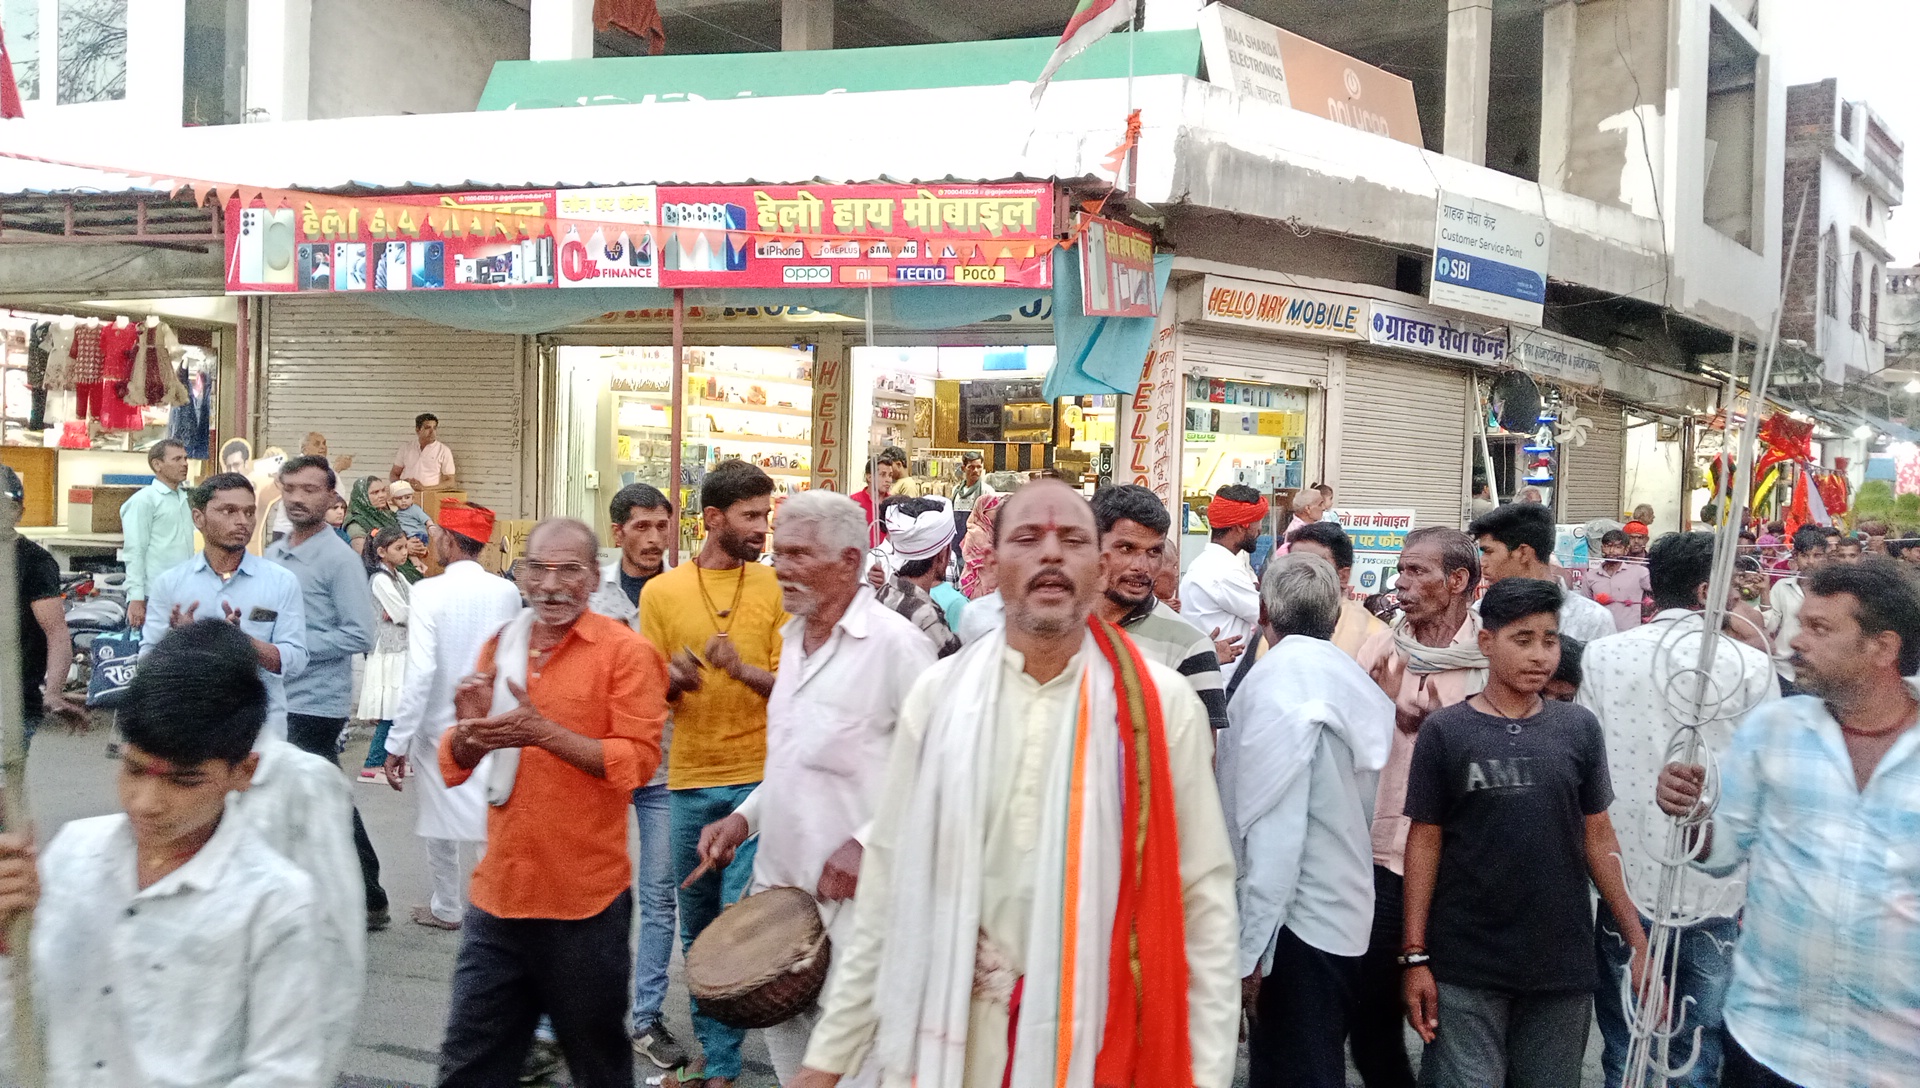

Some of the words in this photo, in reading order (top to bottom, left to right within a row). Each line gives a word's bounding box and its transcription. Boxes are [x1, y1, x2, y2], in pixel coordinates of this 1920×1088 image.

[1224, 26, 1245, 47] MAA
[1246, 34, 1279, 59] SHARDA
[1229, 51, 1284, 81] ELECTRONICS
[754, 190, 824, 229] हेलो
[832, 198, 895, 229] हाय
[902, 188, 1038, 237] मोबाइल
[1443, 204, 1465, 222] ग्राहक
[1466, 207, 1482, 227] सेवा
[766, 245, 801, 256] iPhone
[869, 245, 916, 254] SAMNG
[1441, 227, 1478, 248] Customer
[1479, 237, 1505, 255] Service
[1505, 244, 1523, 259] Point
[609, 251, 620, 259] TV
[602, 267, 652, 279] FINANCE
[897, 267, 946, 281] TECNO
[962, 268, 997, 281] POCO
[1449, 258, 1471, 281] SBI
[1207, 286, 1257, 318] HELLO
[1257, 292, 1288, 322] HAY
[1287, 300, 1361, 334] MOBILE
[1385, 314, 1437, 348] ग्राहक
[1438, 319, 1472, 353] सेवा
[818, 360, 841, 492] HELLO
[1131, 350, 1158, 487] HELLO
[1353, 515, 1371, 527] हाय
[1373, 512, 1411, 529] मोबाइल
[1359, 535, 1376, 547] पर
[1378, 531, 1404, 548] फोन
